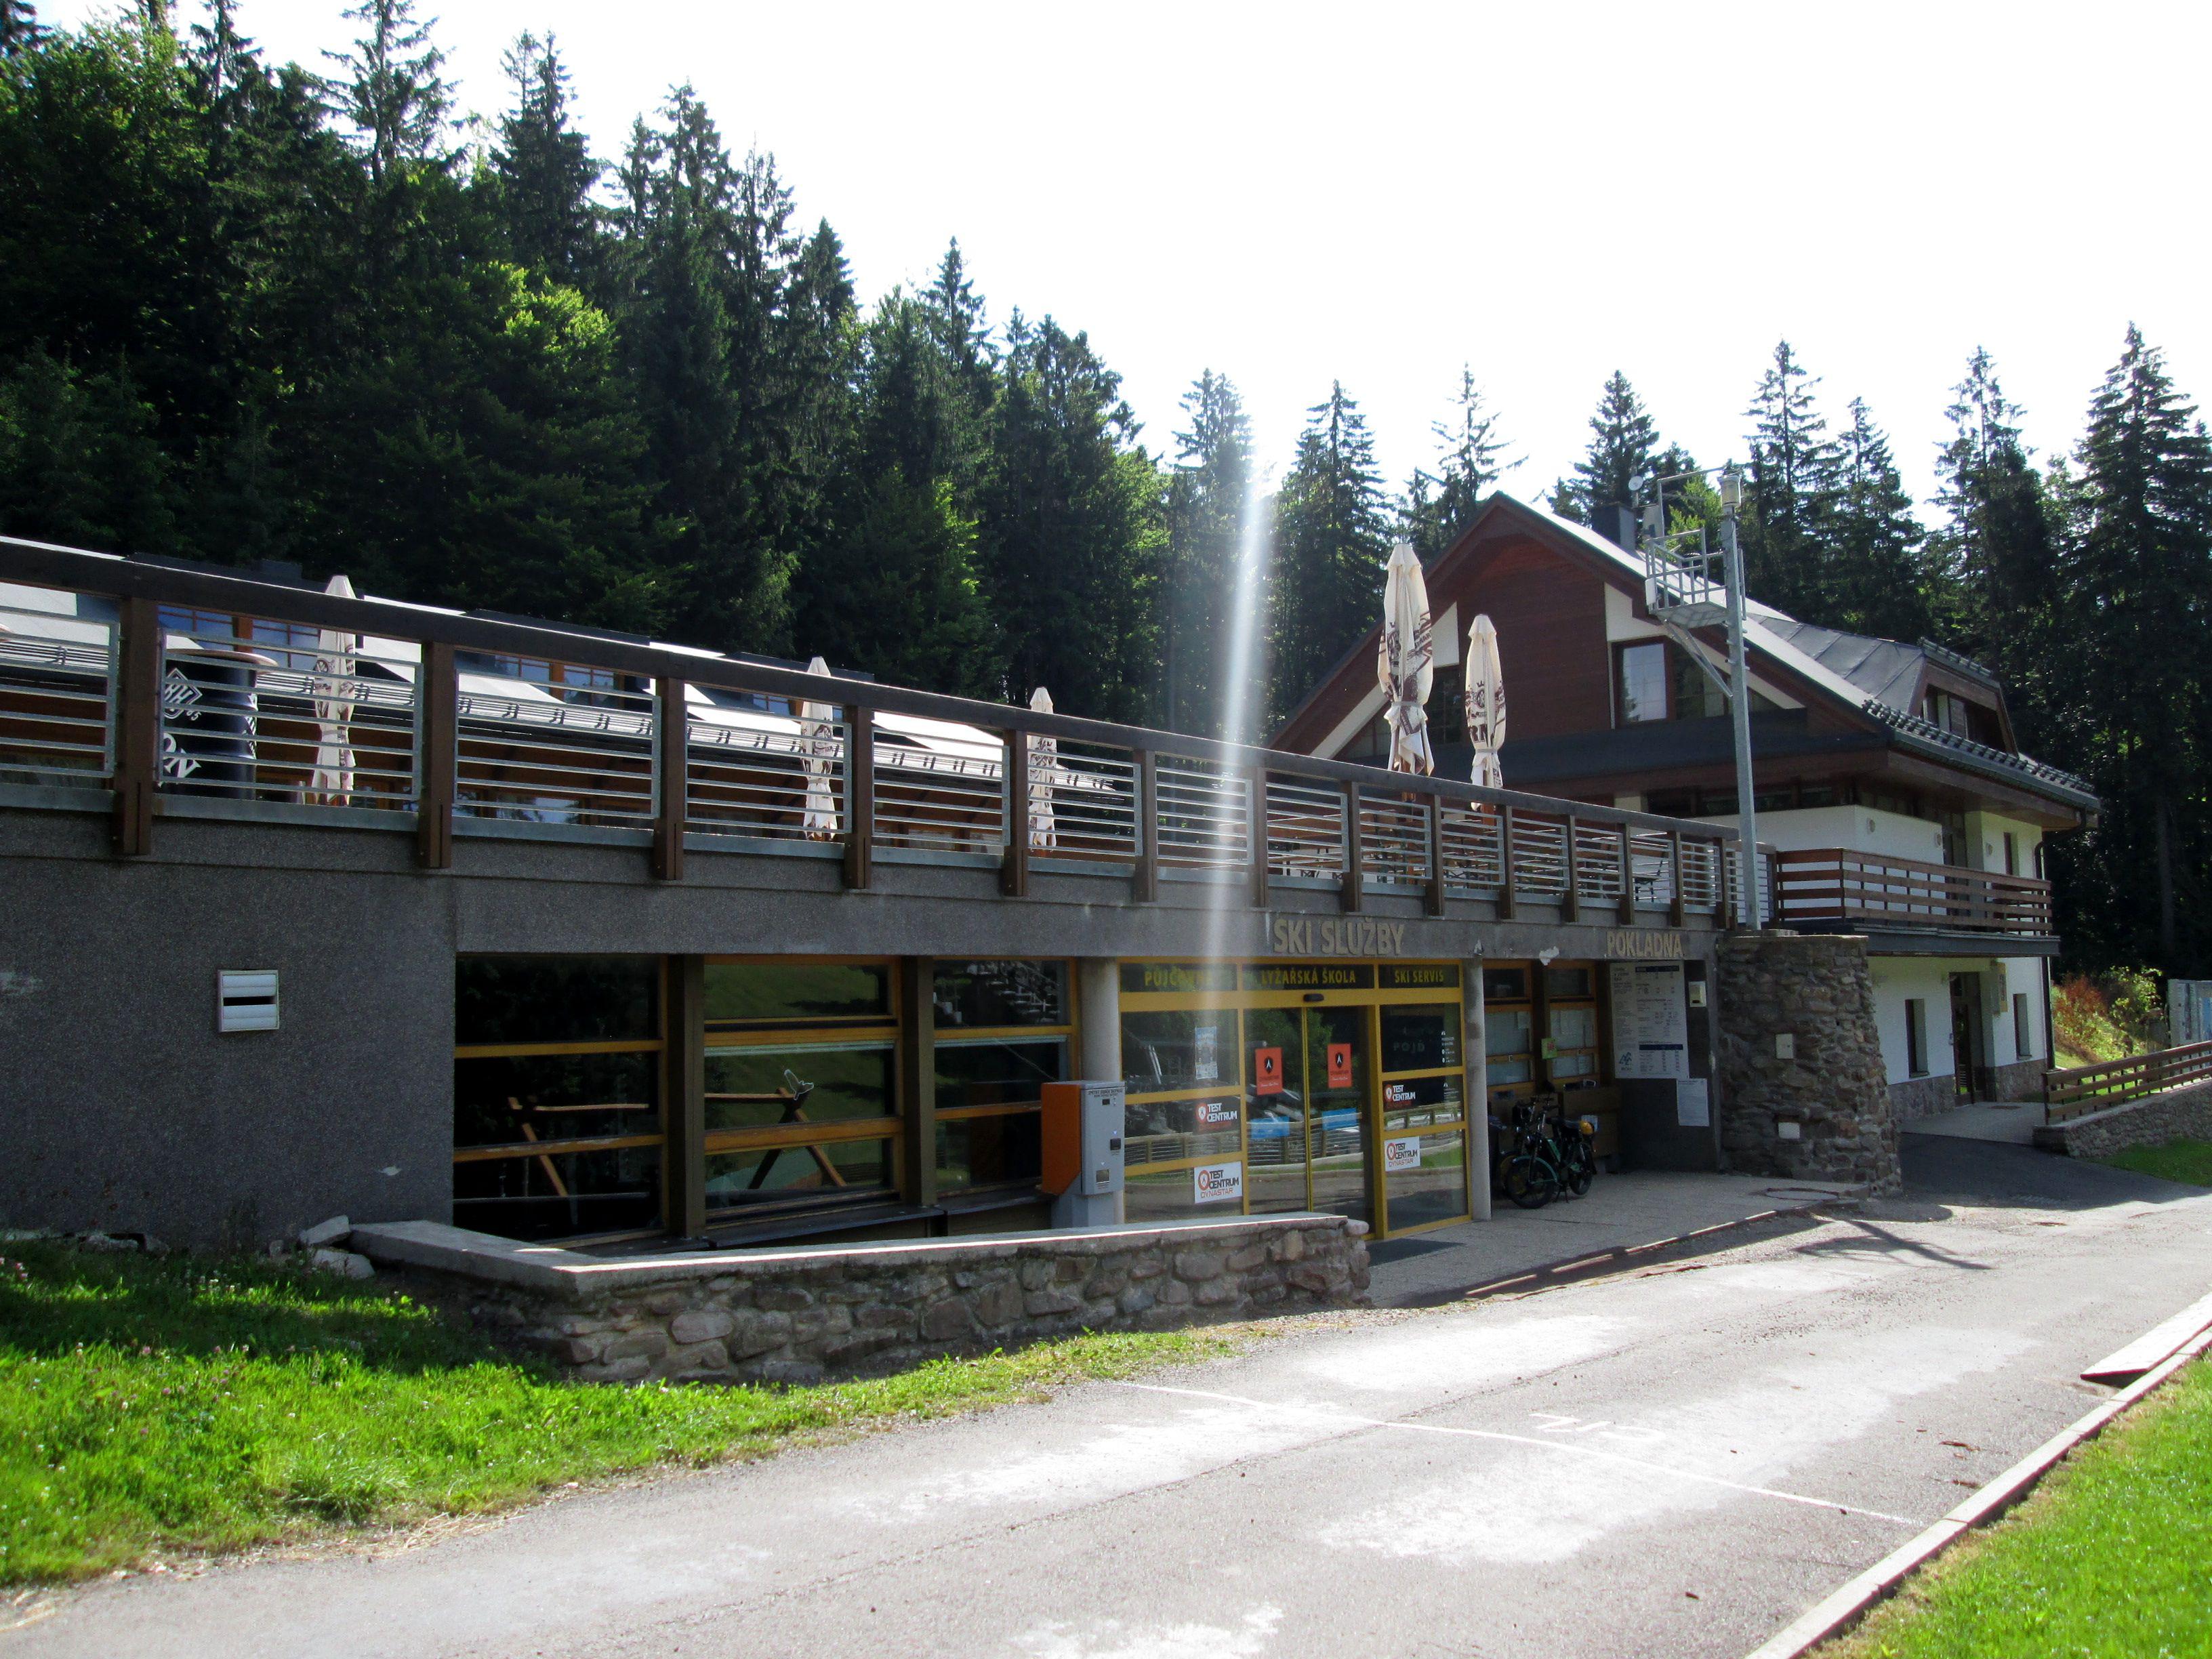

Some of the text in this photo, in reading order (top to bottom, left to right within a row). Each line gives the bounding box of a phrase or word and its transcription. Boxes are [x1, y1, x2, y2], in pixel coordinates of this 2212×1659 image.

[1273, 917, 1405, 955] SKI SLUŽBY
[1605, 930, 1683, 958] POKLADNA
[1261, 966, 1355, 985] LYŽAŘSKÁ ŠKOLA
[1395, 970, 1443, 983] SKI SERVIS
[1393, 1084, 1404, 1093] TEST
[1393, 1092, 1416, 1102] CENTRUM
[1207, 1103, 1222, 1113] TEST
[1206, 1110, 1237, 1123] CENTRUM
[1395, 1143, 1406, 1151] TEST
[1395, 1149, 1418, 1160] CENTRUM
[1209, 1170, 1224, 1179] TEST
[1209, 1176, 1240, 1189] CENTRUM
[1200, 1187, 1234, 1198] DYNASTAR
